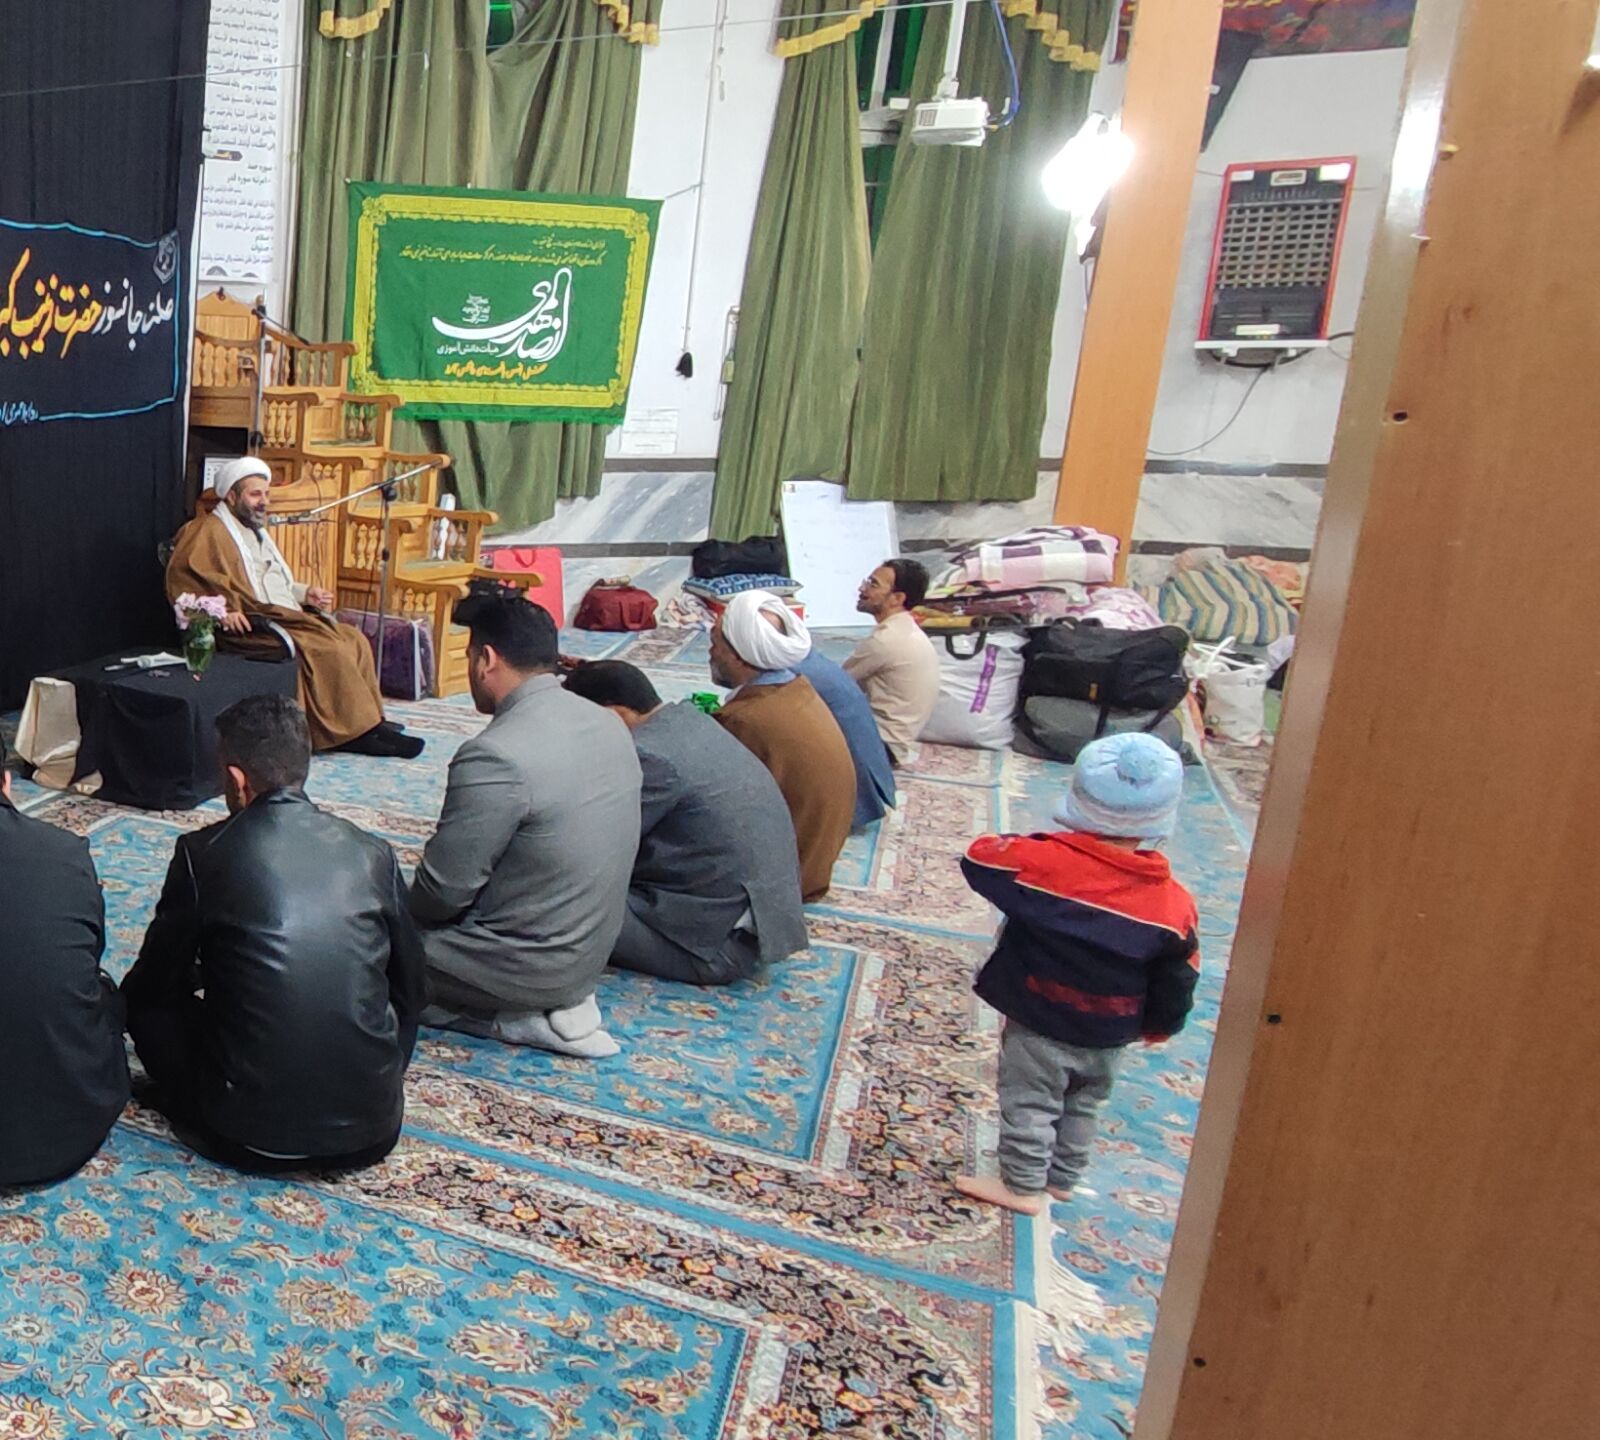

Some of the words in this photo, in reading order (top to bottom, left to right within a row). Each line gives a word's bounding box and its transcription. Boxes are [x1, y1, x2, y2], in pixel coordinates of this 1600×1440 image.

[11, 273, 59, 360] زینب
[54, 282, 103, 360] حضرت
[91, 277, 144, 351] جانسوز
